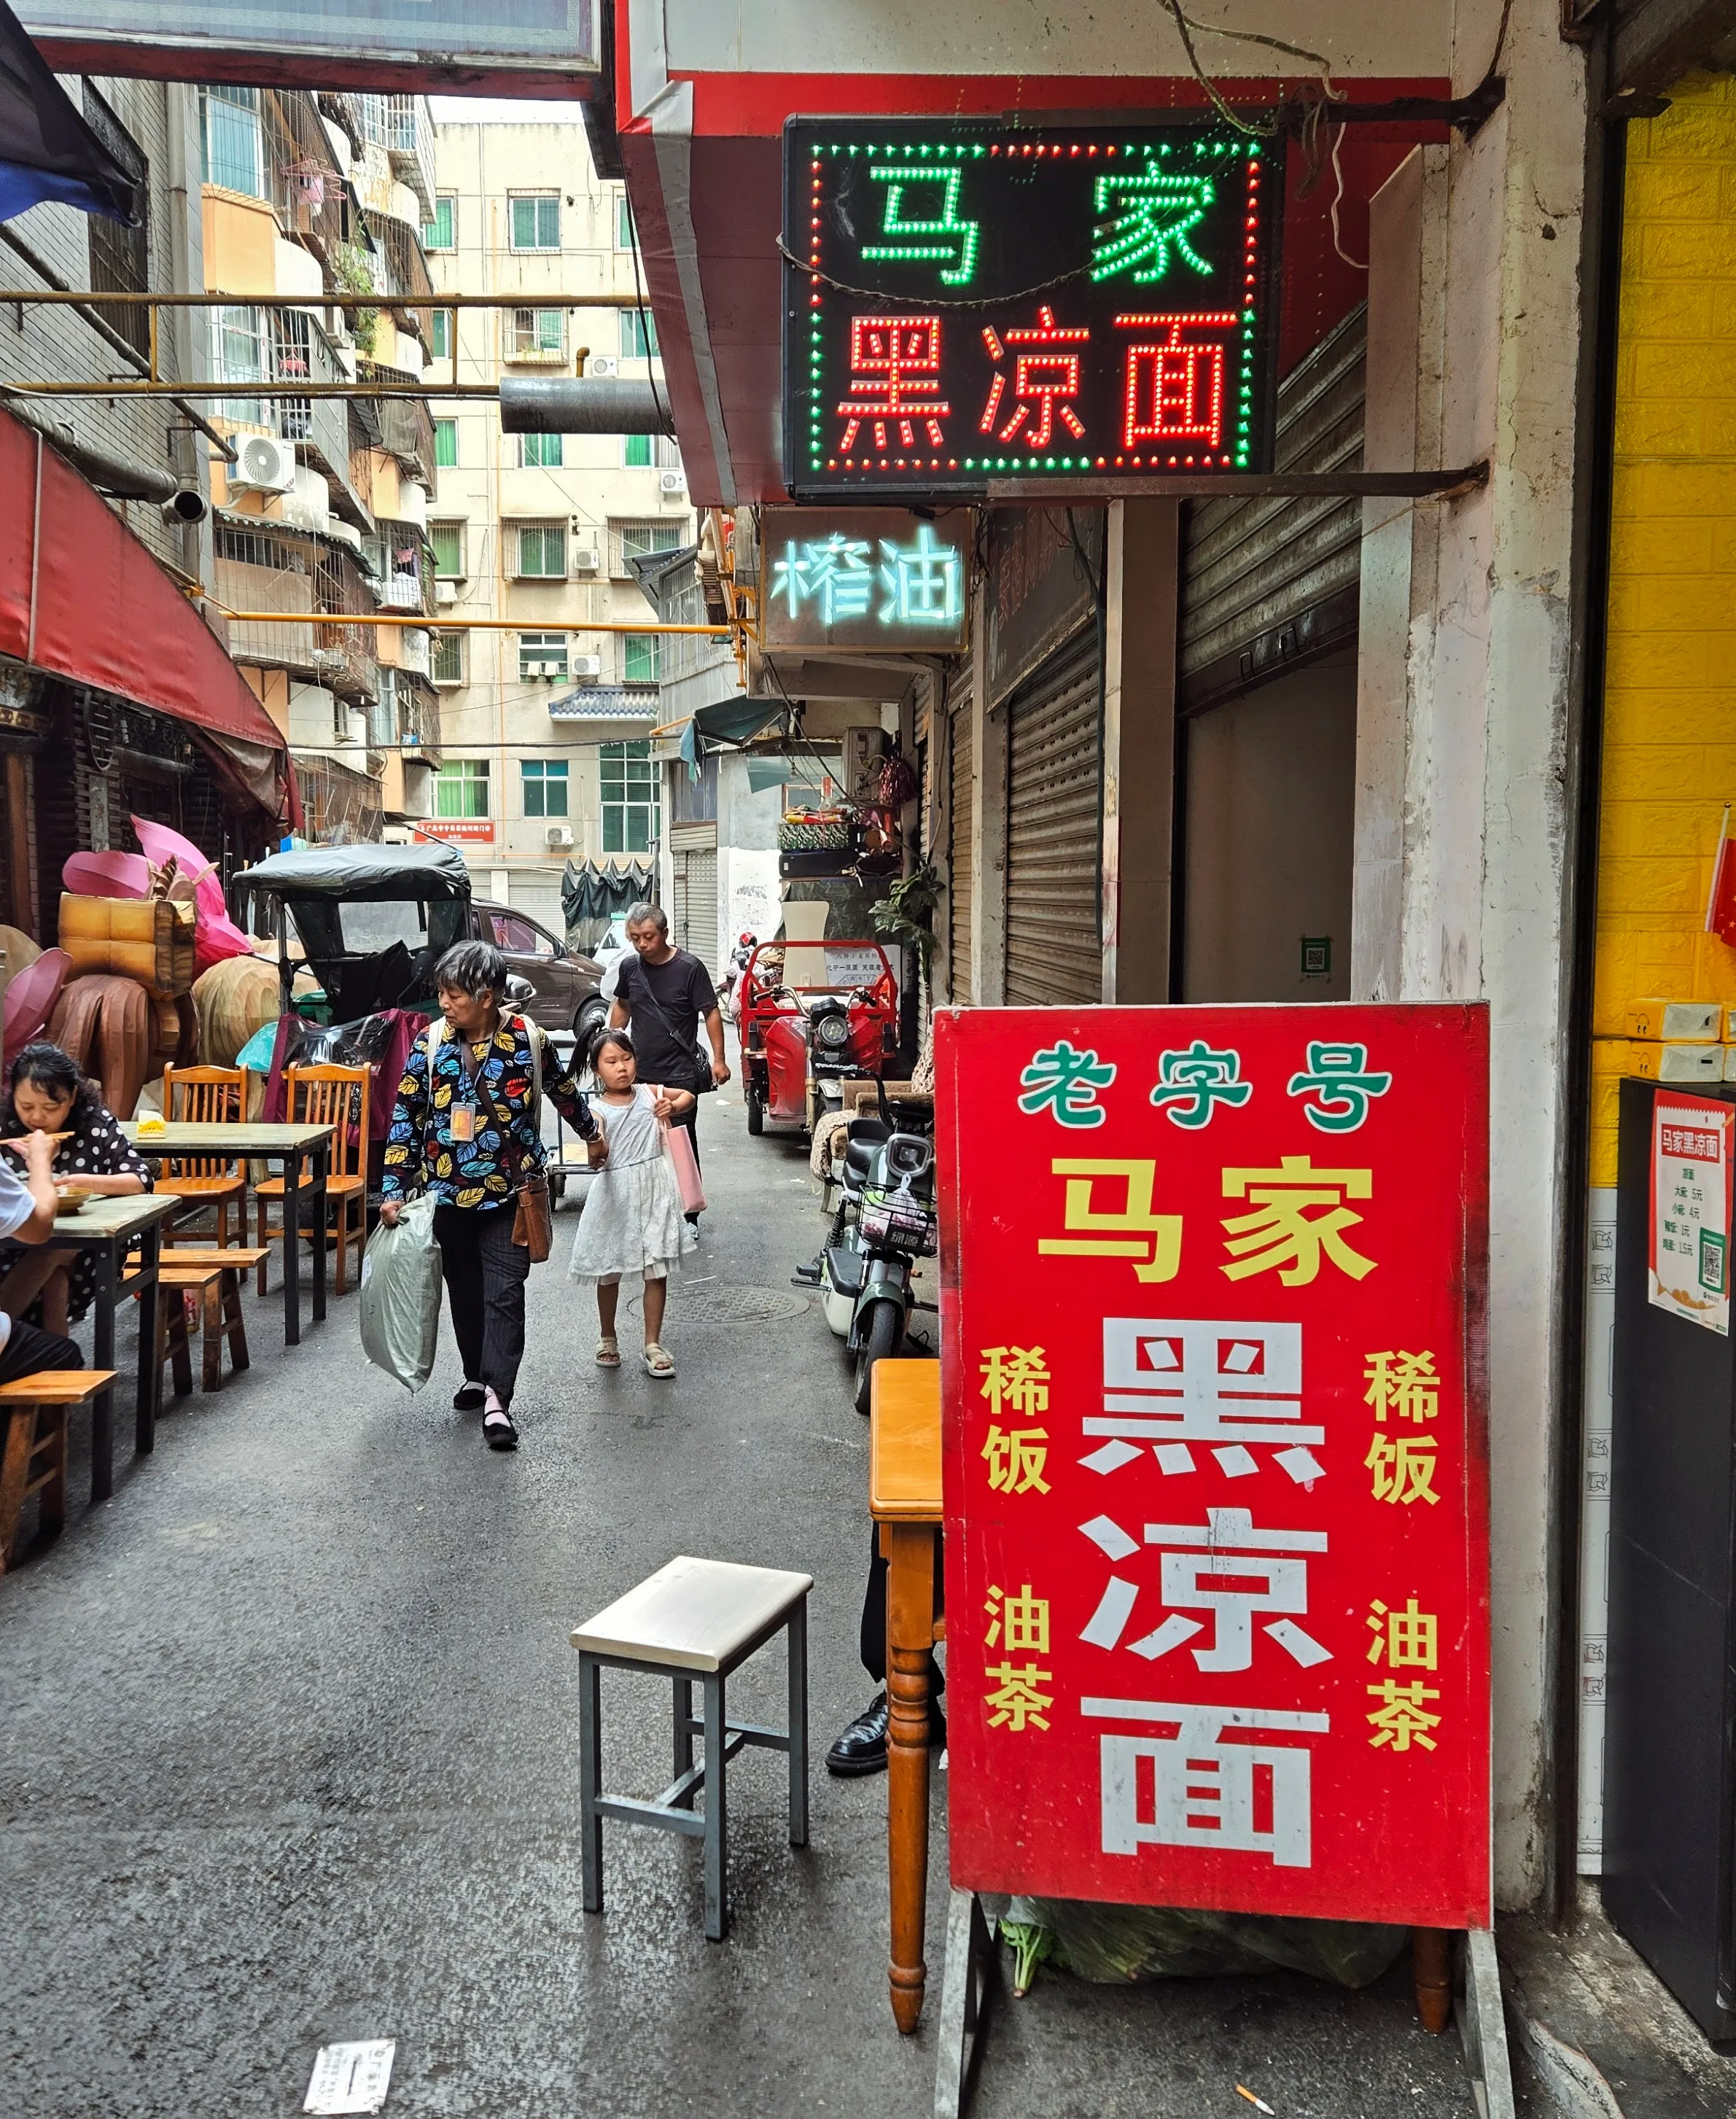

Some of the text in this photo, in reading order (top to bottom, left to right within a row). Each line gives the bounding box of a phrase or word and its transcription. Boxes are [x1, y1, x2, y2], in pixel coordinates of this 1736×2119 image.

[862, 159, 1216, 285] 马家
[837, 306, 1238, 454] 黑凉面
[770, 526, 962, 624] 榨油
[1018, 1039, 1392, 1134] 老字号
[1662, 1129, 1719, 1159] 马家黑凉面
[1692, 1188, 1703, 1202] 5元
[890, 1231, 919, 1248] 绿源
[1038, 1156, 1379, 1287] 马家
[1689, 1205, 1701, 1219] 4元
[979, 1345, 1054, 1733] 稀饭 油茶
[1077, 1317, 1334, 1868] 黑凉面
[1363, 1349, 1442, 1752] 稀饭 油茶
